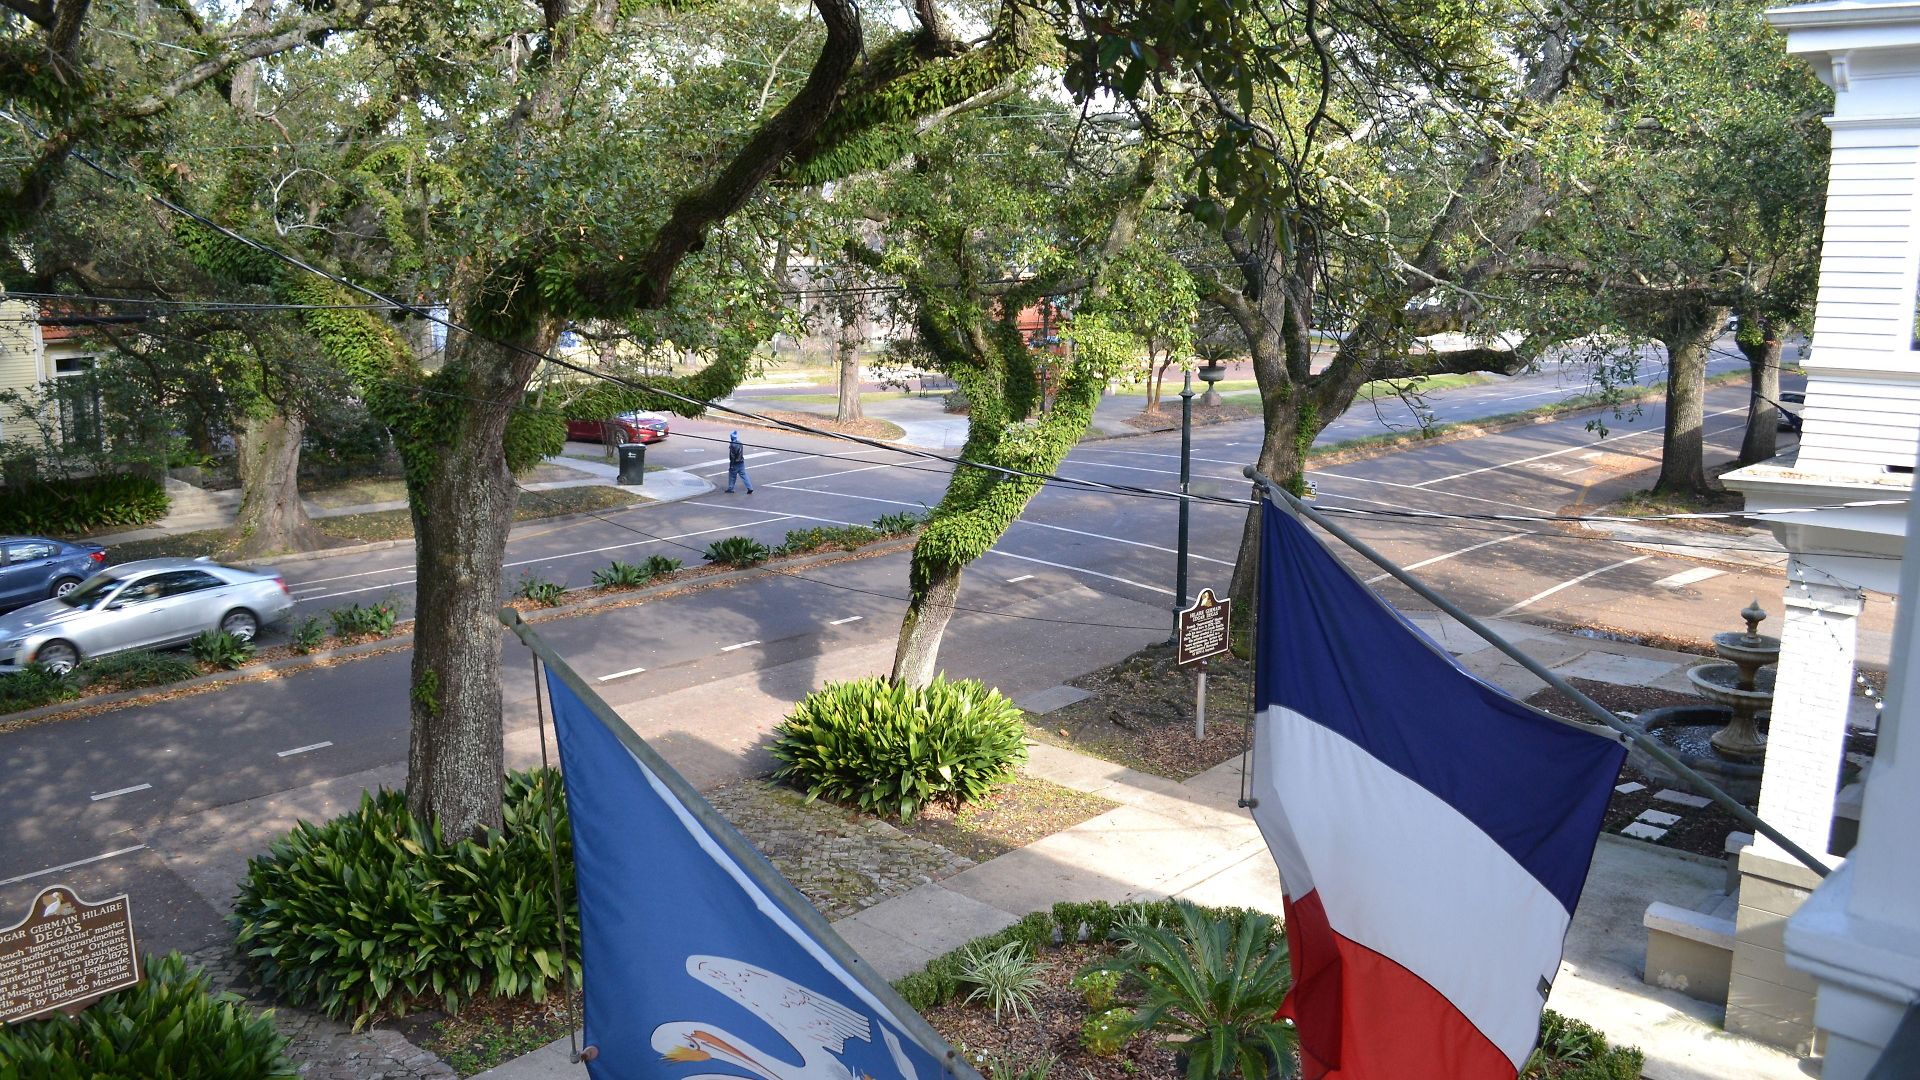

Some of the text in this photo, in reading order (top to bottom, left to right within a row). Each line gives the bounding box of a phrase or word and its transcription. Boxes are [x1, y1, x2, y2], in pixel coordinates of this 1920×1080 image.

[30, 914, 78, 934] GERMAIN
[82, 902, 123, 920] HILAIRE
[35, 922, 82, 943] DEGAS
[0, 949, 24, 961] ench
[95, 920, 125, 934] master
[22, 949, 52, 963] mother
[53, 942, 70, 954] and
[70, 928, 126, 951] grandmother
[0, 968, 17, 977] ere
[22, 960, 45, 971] born
[50, 955, 59, 963] in
[63, 948, 84, 959] New
[22, 975, 42, 986] visit
[46, 968, 68, 980] here
[84, 948, 129, 968] 1872-1873
[31, 964, 56, 977] many
[58, 954, 90, 968] famous
[91, 942, 129, 957] subjects
[8, 984, 42, 999] Musson
[43, 975, 70, 988] Home
[71, 971, 82, 979] on
[36, 997, 48, 1007] by
[52, 984, 90, 1001] Delgado
[92, 971, 132, 988] Museum.
[77, 976, 87, 985] of
